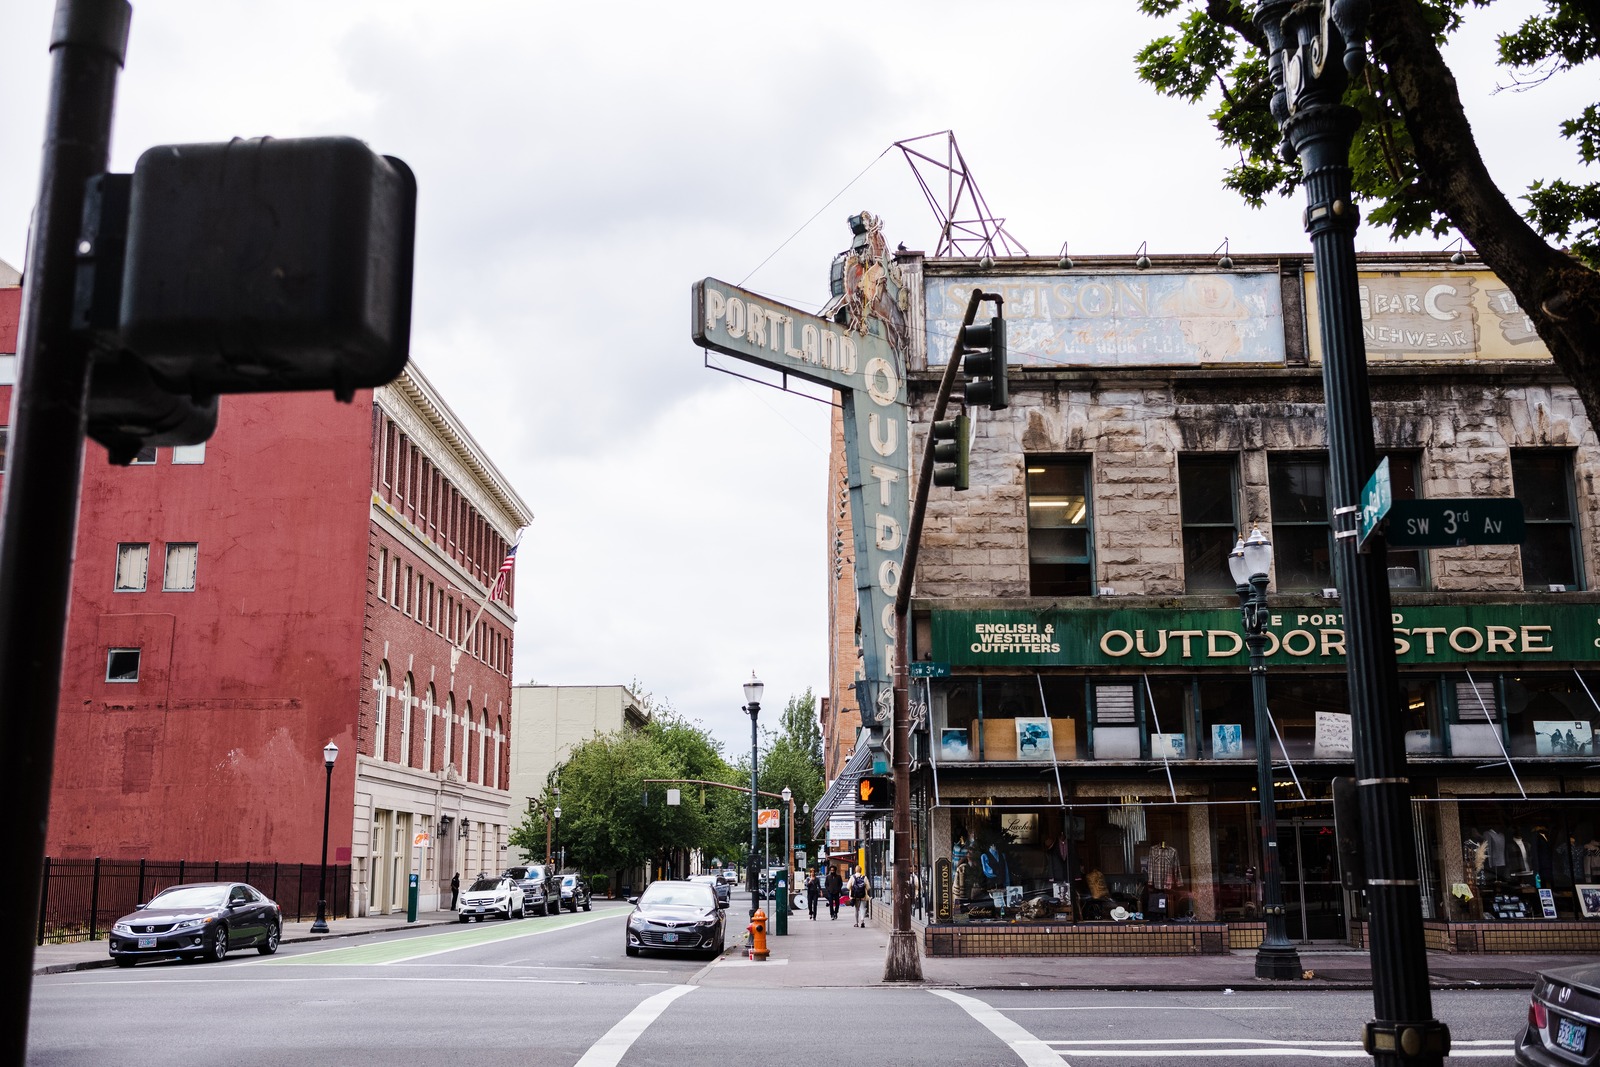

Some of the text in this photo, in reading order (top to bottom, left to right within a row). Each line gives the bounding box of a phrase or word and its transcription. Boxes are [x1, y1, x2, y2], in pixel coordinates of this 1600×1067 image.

[946, 282, 1150, 319] STETSON
[1374, 293, 1421, 314] BAR
[1423, 284, 1458, 321] C
[705, 288, 858, 375] PORTLAND
[1363, 325, 1468, 348] NCHWEAR
[1406, 509, 1502, 535] SW 3rd Av
[975, 624, 1054, 634] ENGLISH &
[1297, 613, 1404, 626] PORTD
[970, 643, 1061, 653] OUTFITTERS
[980, 633, 1051, 644] WESTERN
[1100, 628, 1346, 658] OUTDOOR
[874, 687, 928, 723] Sre
[940, 865, 950, 916] PENDLETON
